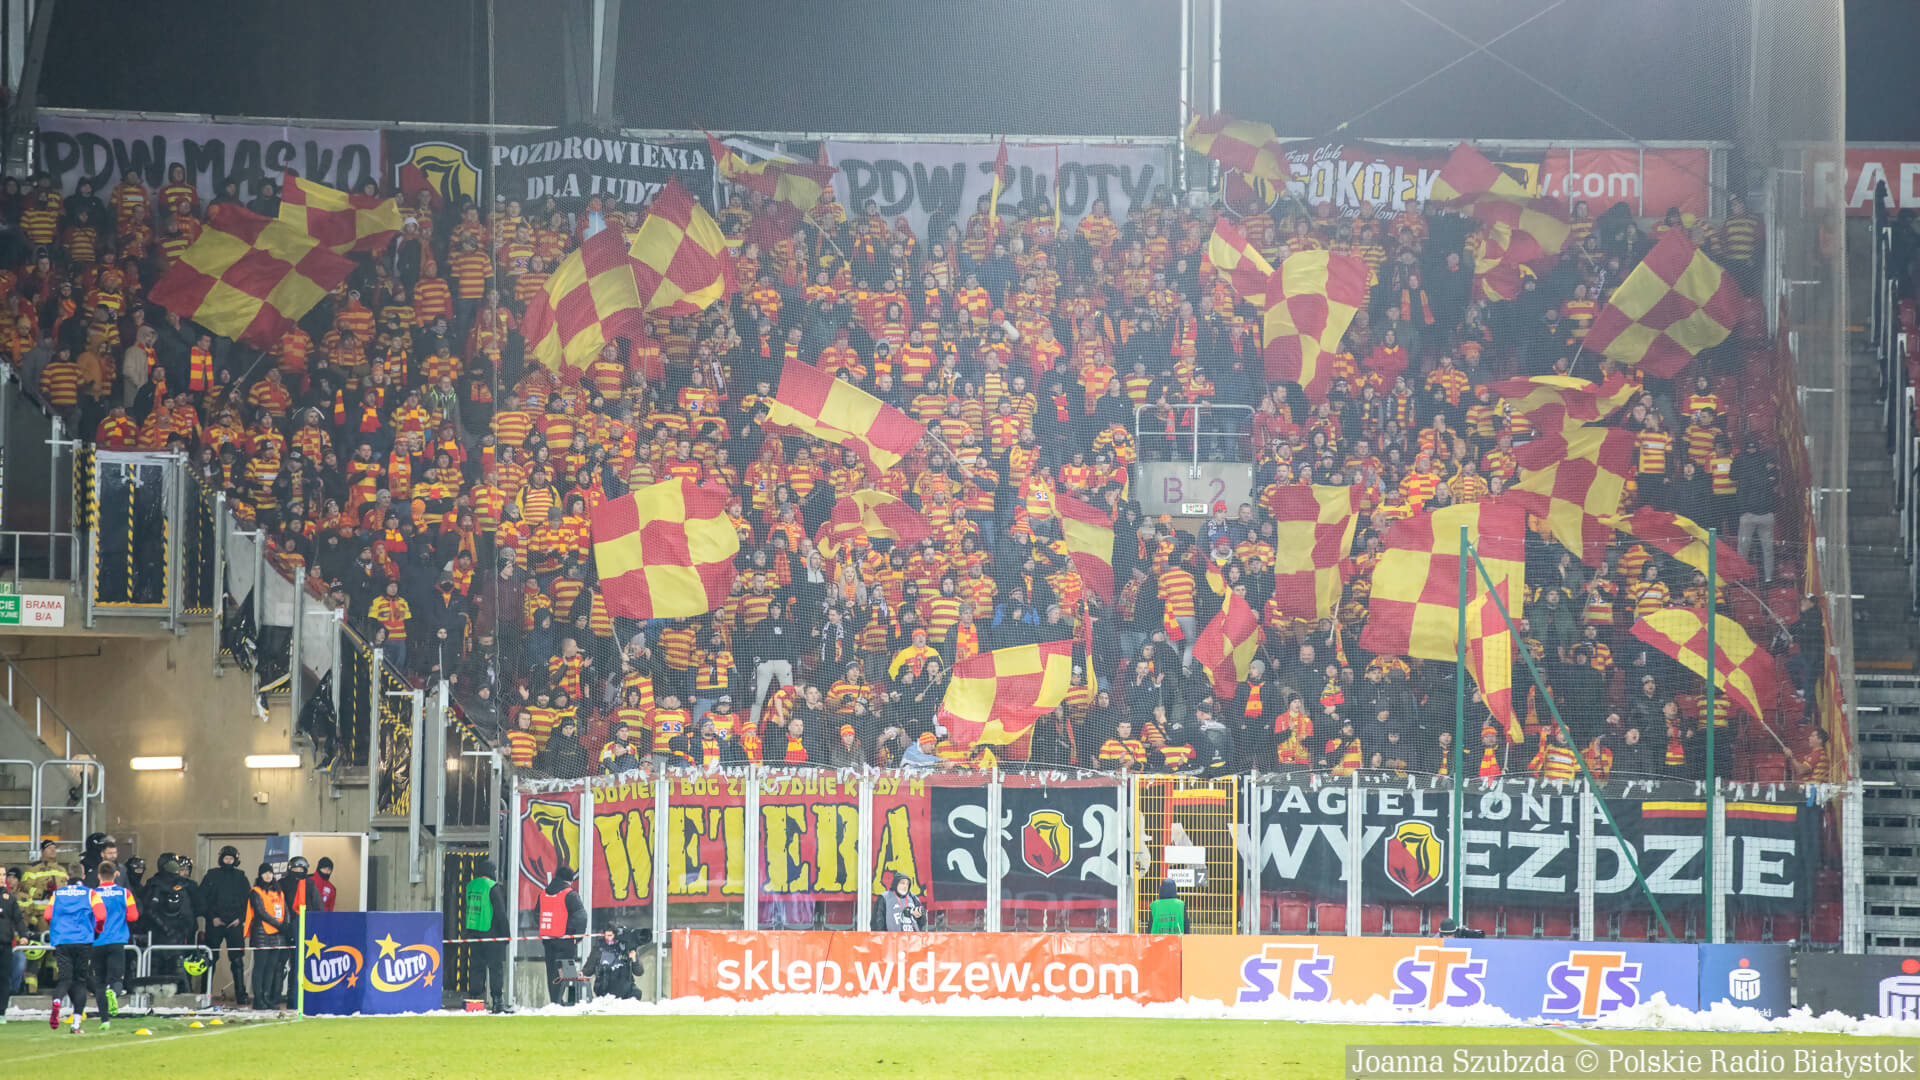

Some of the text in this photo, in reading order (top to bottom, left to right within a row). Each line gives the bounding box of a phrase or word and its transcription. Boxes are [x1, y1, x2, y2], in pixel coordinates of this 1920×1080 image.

[491, 136, 705, 170] POZDROWIENIA
[1312, 144, 1344, 162] Club
[527, 174, 581, 200] DLA
[1163, 477, 1226, 504] B 2
[25, 600, 62, 609] BRAMA
[35, 612, 52, 621] B/A
[1197, 873, 1205, 883] 7
[311, 954, 351, 982] LOTTO
[385, 953, 427, 983] LOTTO
[716, 950, 1140, 994] sklep.widzew.com
[1237, 944, 1335, 1002] STS
[1390, 946, 1487, 1010] STS
[1543, 950, 1643, 1020] STS
